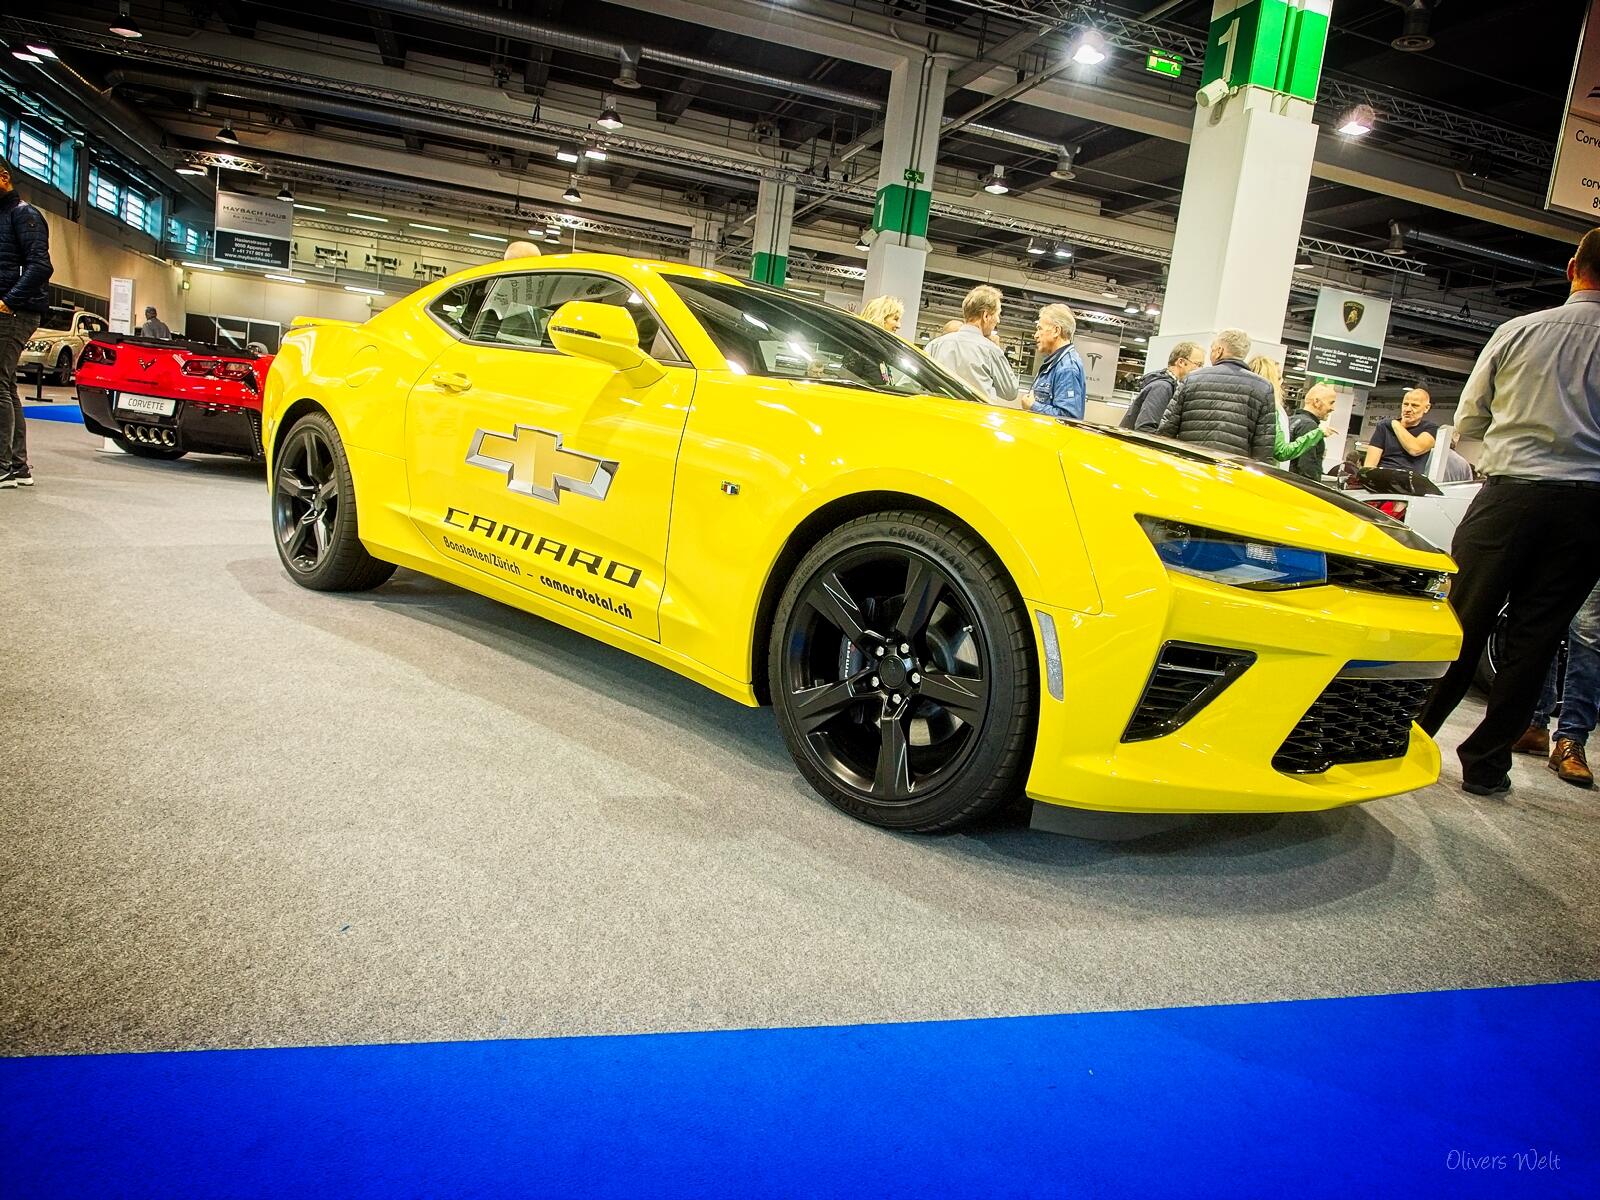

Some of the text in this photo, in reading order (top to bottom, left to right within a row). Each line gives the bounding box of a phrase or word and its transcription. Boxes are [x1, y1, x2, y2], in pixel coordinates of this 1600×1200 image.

[1218, 17, 1241, 82] 1
[223, 206, 263, 215] MAYBACH
[264, 211, 287, 220] HAUS
[878, 192, 886, 228] 1
[128, 398, 164, 411] CORVETTE
[443, 506, 643, 589] CAMARO
[442, 535, 521, 576] Bonstetten/Zürich
[540, 574, 633, 620] camarototal.ch
